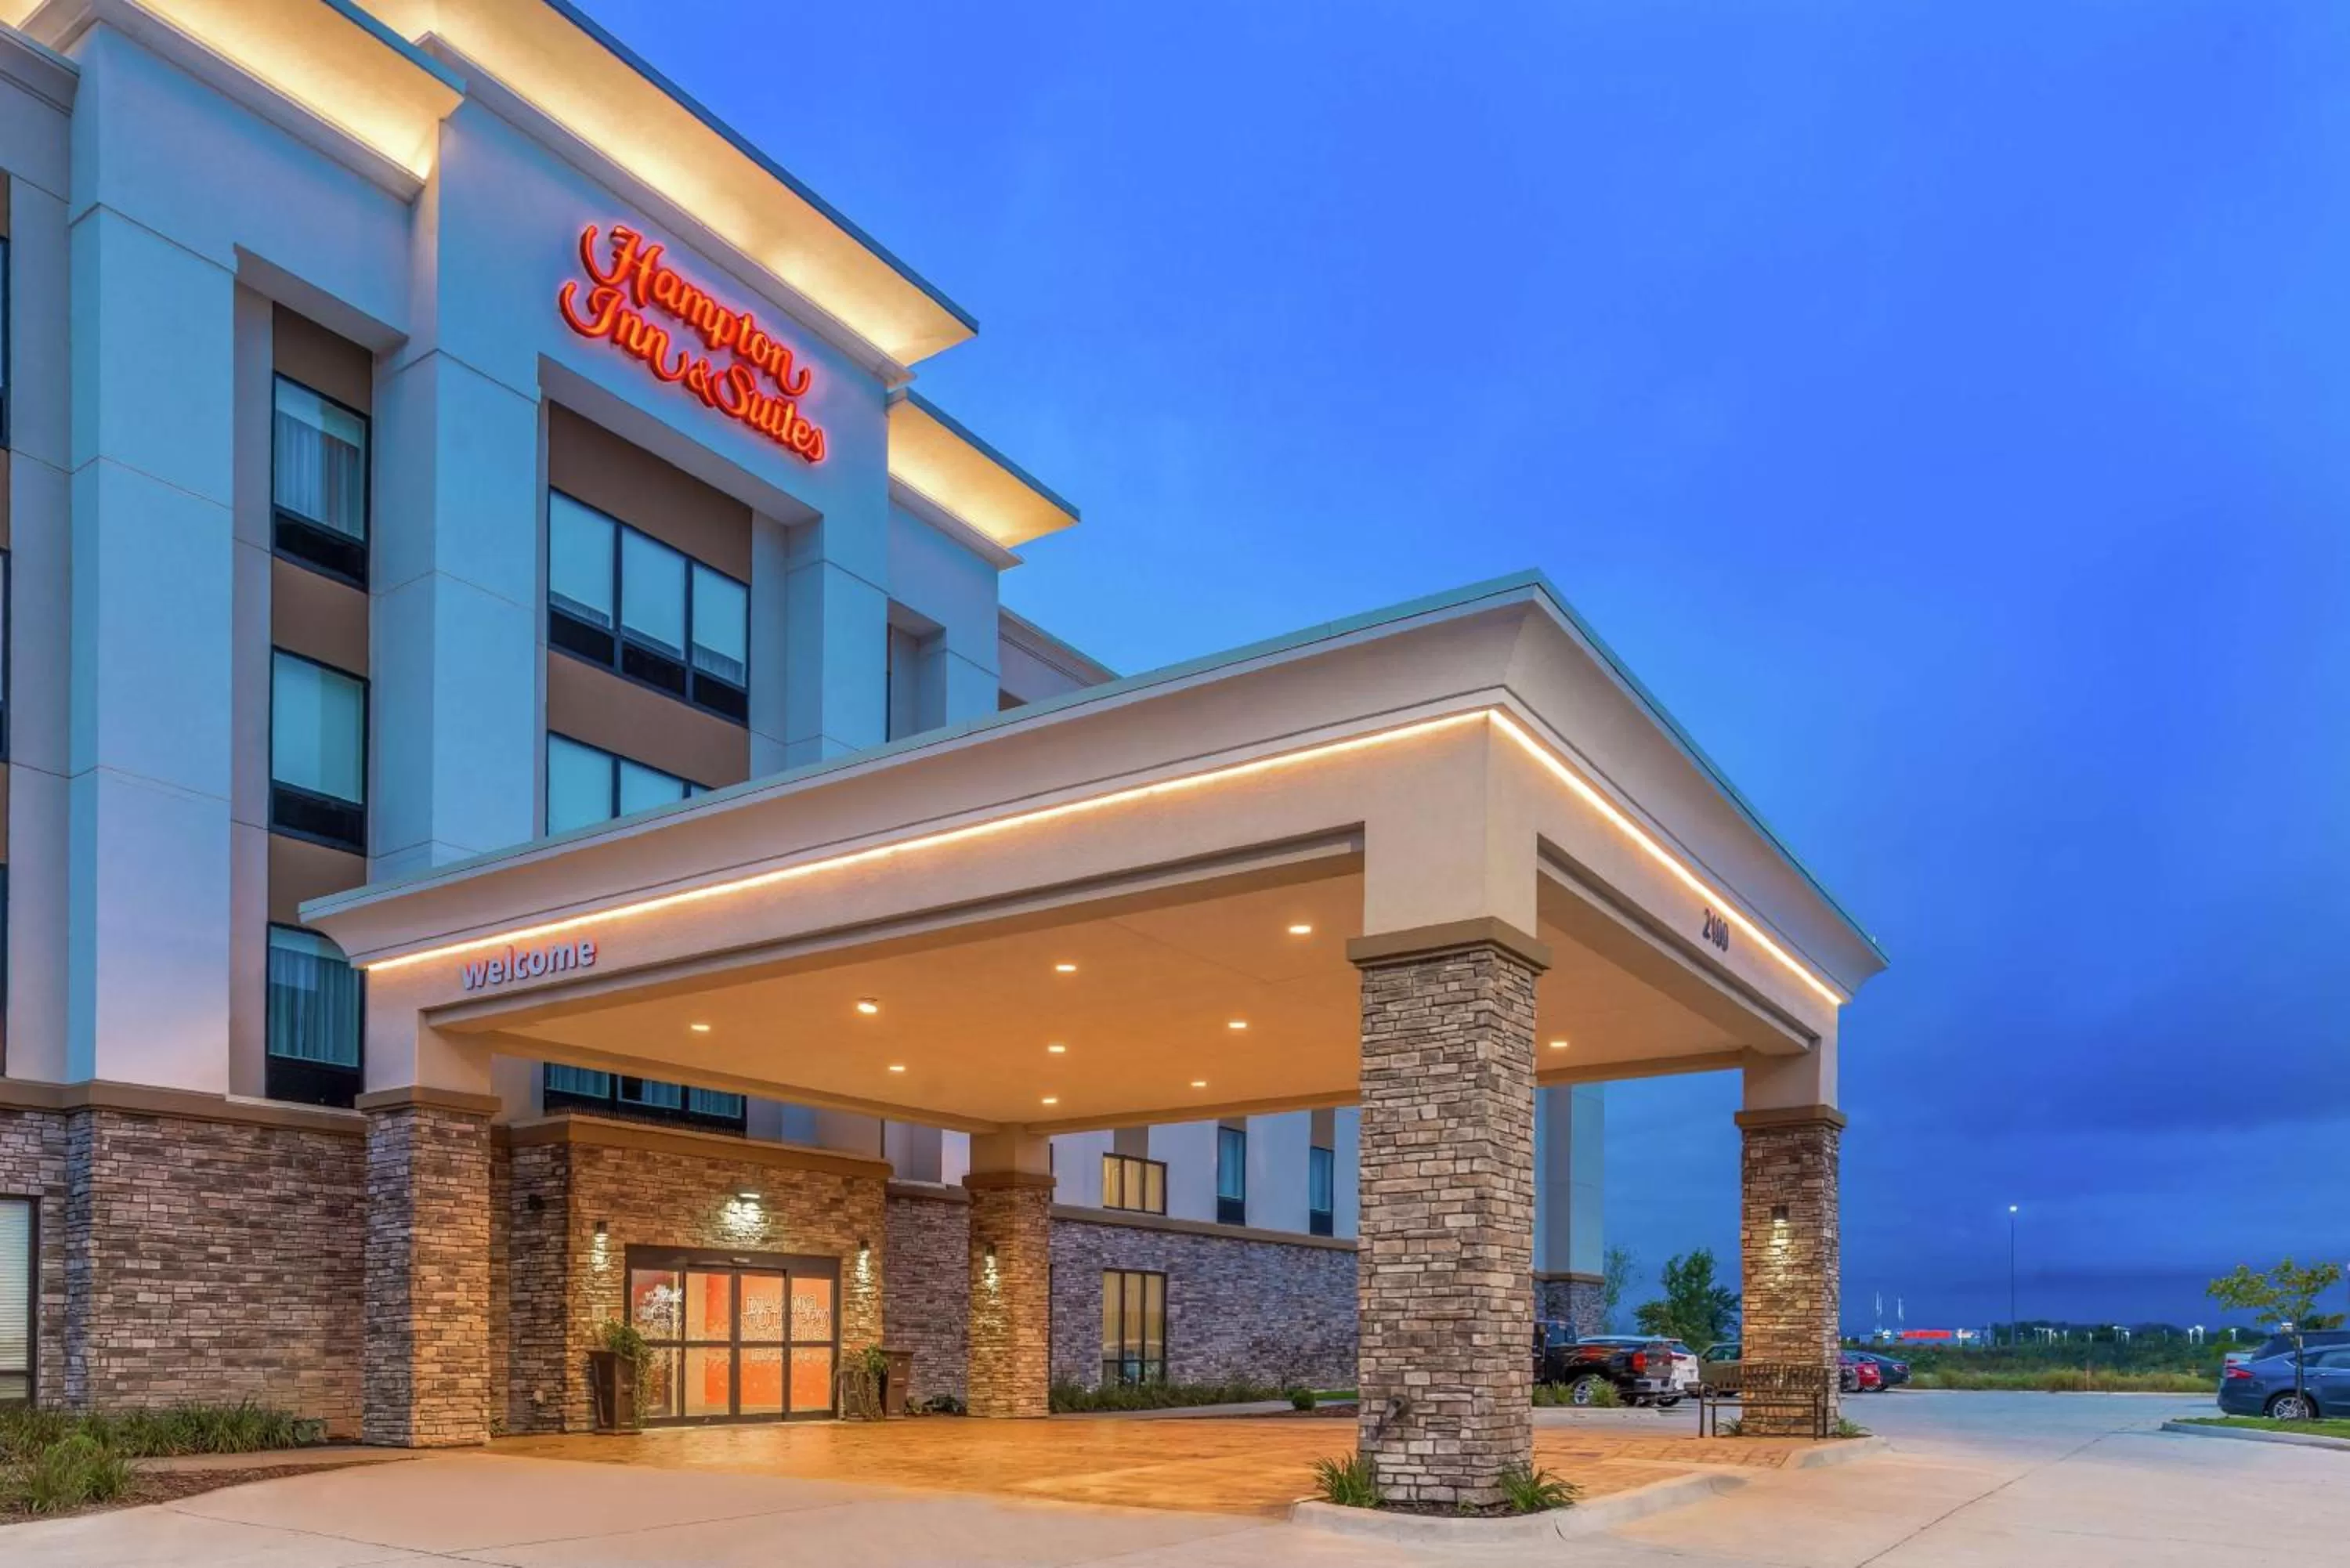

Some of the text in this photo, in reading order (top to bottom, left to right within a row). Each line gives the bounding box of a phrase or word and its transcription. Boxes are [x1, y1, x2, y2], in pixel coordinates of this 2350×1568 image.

[579, 224, 811, 396] Hampton
[559, 281, 826, 463] Inn & Suites
[459, 938, 597, 990] welcome
[1702, 908, 1729, 952] 2100
